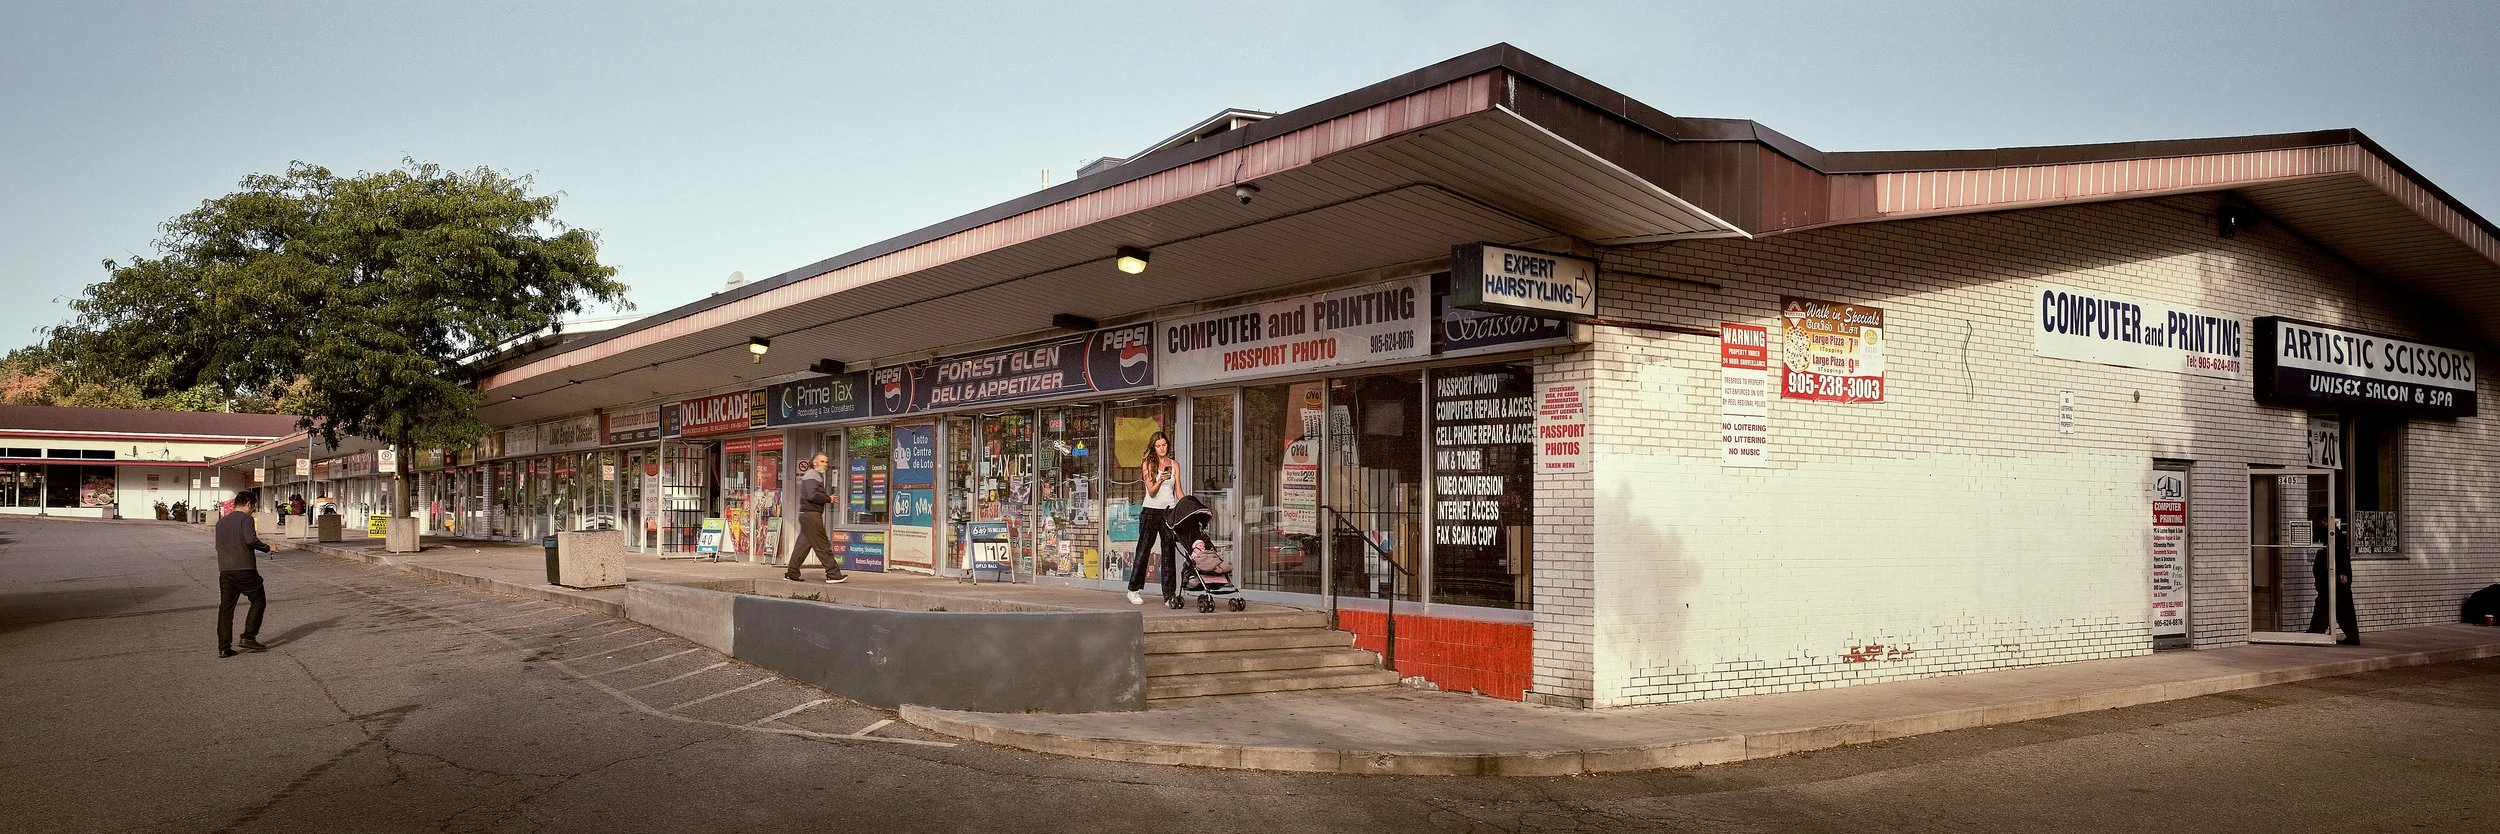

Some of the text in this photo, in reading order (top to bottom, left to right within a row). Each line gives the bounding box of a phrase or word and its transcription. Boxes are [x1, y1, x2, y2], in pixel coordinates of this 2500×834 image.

[1504, 253, 1556, 279] EXPERT
[1486, 274, 1573, 304] HAIRSTYLING
[1168, 287, 1415, 354] COMPUTER and PRINTING
[1806, 302, 1880, 326] Walk in Specials
[2043, 290, 2240, 357] COMPUTER and PRINTING
[1102, 326, 1149, 351] PEPSI
[1370, 330, 1414, 354] 905-624-8876
[1723, 327, 1765, 347] WARNING
[1812, 334, 1844, 346] Large Pizza
[938, 346, 1060, 382] FOREST GLEN
[1224, 338, 1336, 372] PASSPORT PHOTO
[1812, 354, 1844, 366] Large Pizza
[2186, 355, 2240, 373] Tel: 905-624-8876
[2284, 327, 2472, 382] ARTISTIC SCISSORS
[875, 367, 902, 386] PEPSI
[1438, 374, 1497, 397] PASSPORT PHOTO
[1724, 376, 1742, 385] TRESPASS
[1788, 372, 1880, 399] 905-238-3003
[798, 380, 852, 406] Prime Tax
[932, 372, 1063, 404] DELI & APPETIZER
[2310, 374, 2453, 407] UNISEX SALON & SPA
[752, 392, 765, 406] ATM
[1436, 400, 1473, 420] COMPUTER
[1475, 399, 1500, 418] REPAIR
[1502, 398, 1506, 417] &
[682, 394, 748, 426] DOLLARCADE
[797, 408, 818, 417] Accounting
[831, 404, 854, 413] Consultants
[560, 425, 574, 444] English
[576, 424, 592, 442] Classes
[1436, 426, 1452, 445] CELL
[1454, 425, 1477, 445] PHONE
[1478, 424, 1504, 444] REPAIR
[1505, 424, 1510, 443] &
[1540, 424, 1585, 438] PASSPORT
[1734, 424, 1766, 432] LOITERING
[914, 435, 928, 444] Lotto
[1546, 442, 1580, 455] PHOTOS
[1735, 436, 1766, 444] LITTERING
[913, 447, 931, 456] Centre
[1437, 451, 1480, 470] INK & TONER
[913, 459, 933, 468] de Loto
[991, 454, 1032, 476] FAX ICE
[1437, 476, 1503, 495] VIDEO CONVERSION
[2278, 476, 2297, 485] 3405
[1438, 500, 1499, 520] INTERNET ACCESS
[2154, 503, 2181, 511] COMPUTER
[2160, 515, 2182, 523] PRINTING
[973, 526, 988, 535] 649
[1437, 526, 1497, 545] FAX SCAN & COPY
